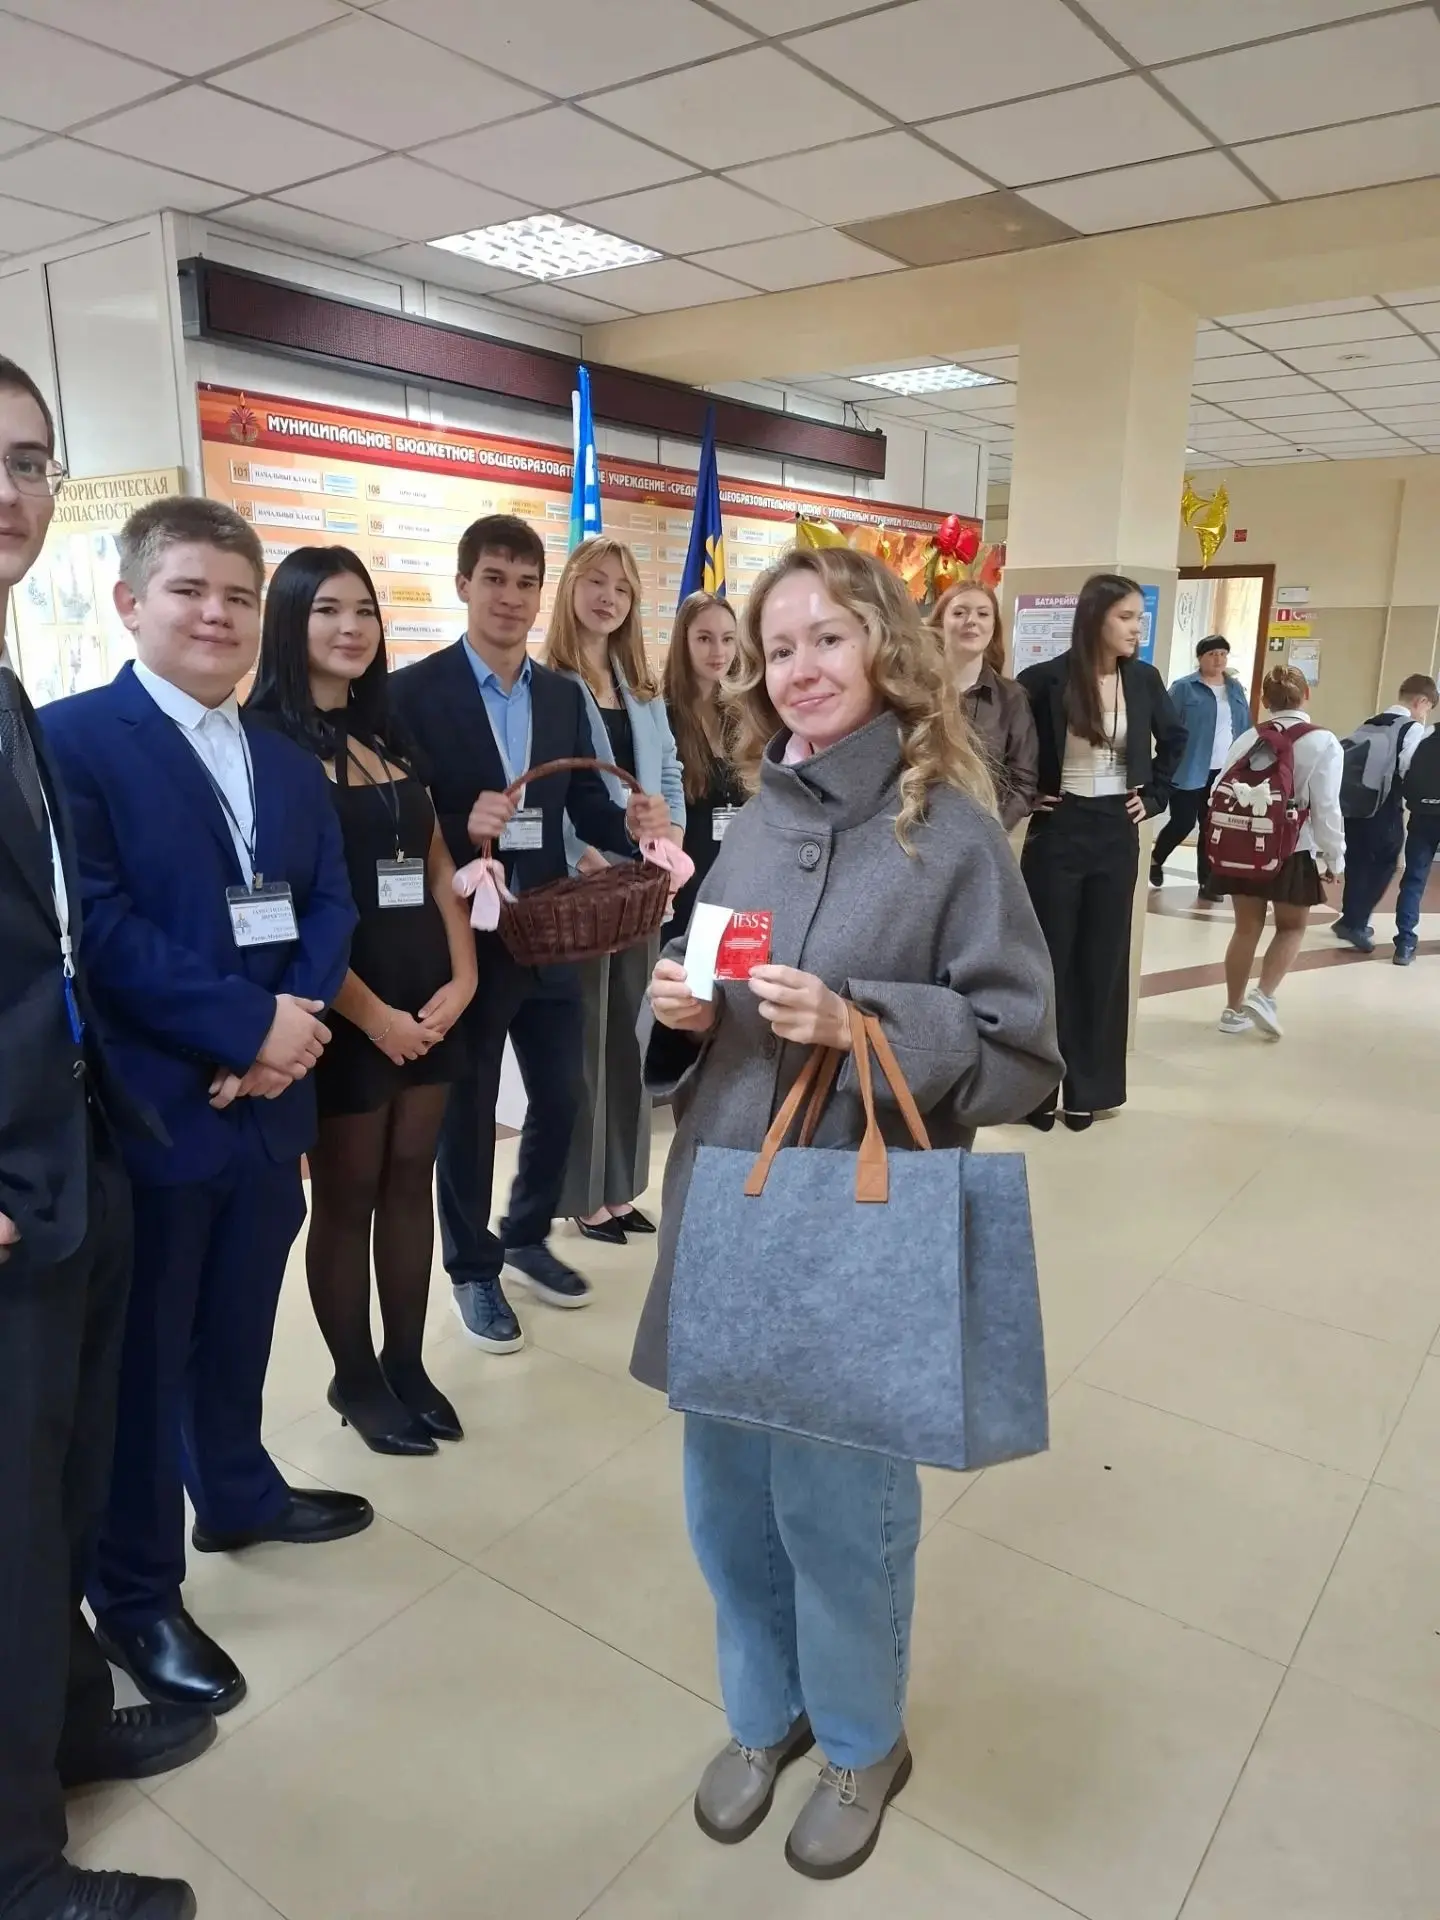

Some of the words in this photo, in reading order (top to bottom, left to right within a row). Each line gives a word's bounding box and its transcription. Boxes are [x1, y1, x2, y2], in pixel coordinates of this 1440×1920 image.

[267, 414, 392, 450] МУНИЦИПАЛЬНОЕ
[395, 436, 476, 463] БЮДЖЕТНОЕ
[608, 474, 665, 493] УЧРЕЖДЕНИЕ
[668, 483, 698, 498] «СРЕДН
[719, 491, 796, 513] ЩЕОБРАЗОВАТЕЛЬНАЯ
[233, 466, 248, 477] 101
[372, 555, 384, 566] 112
[377, 591, 386, 600] 13
[732, 914, 760, 929] TESS
